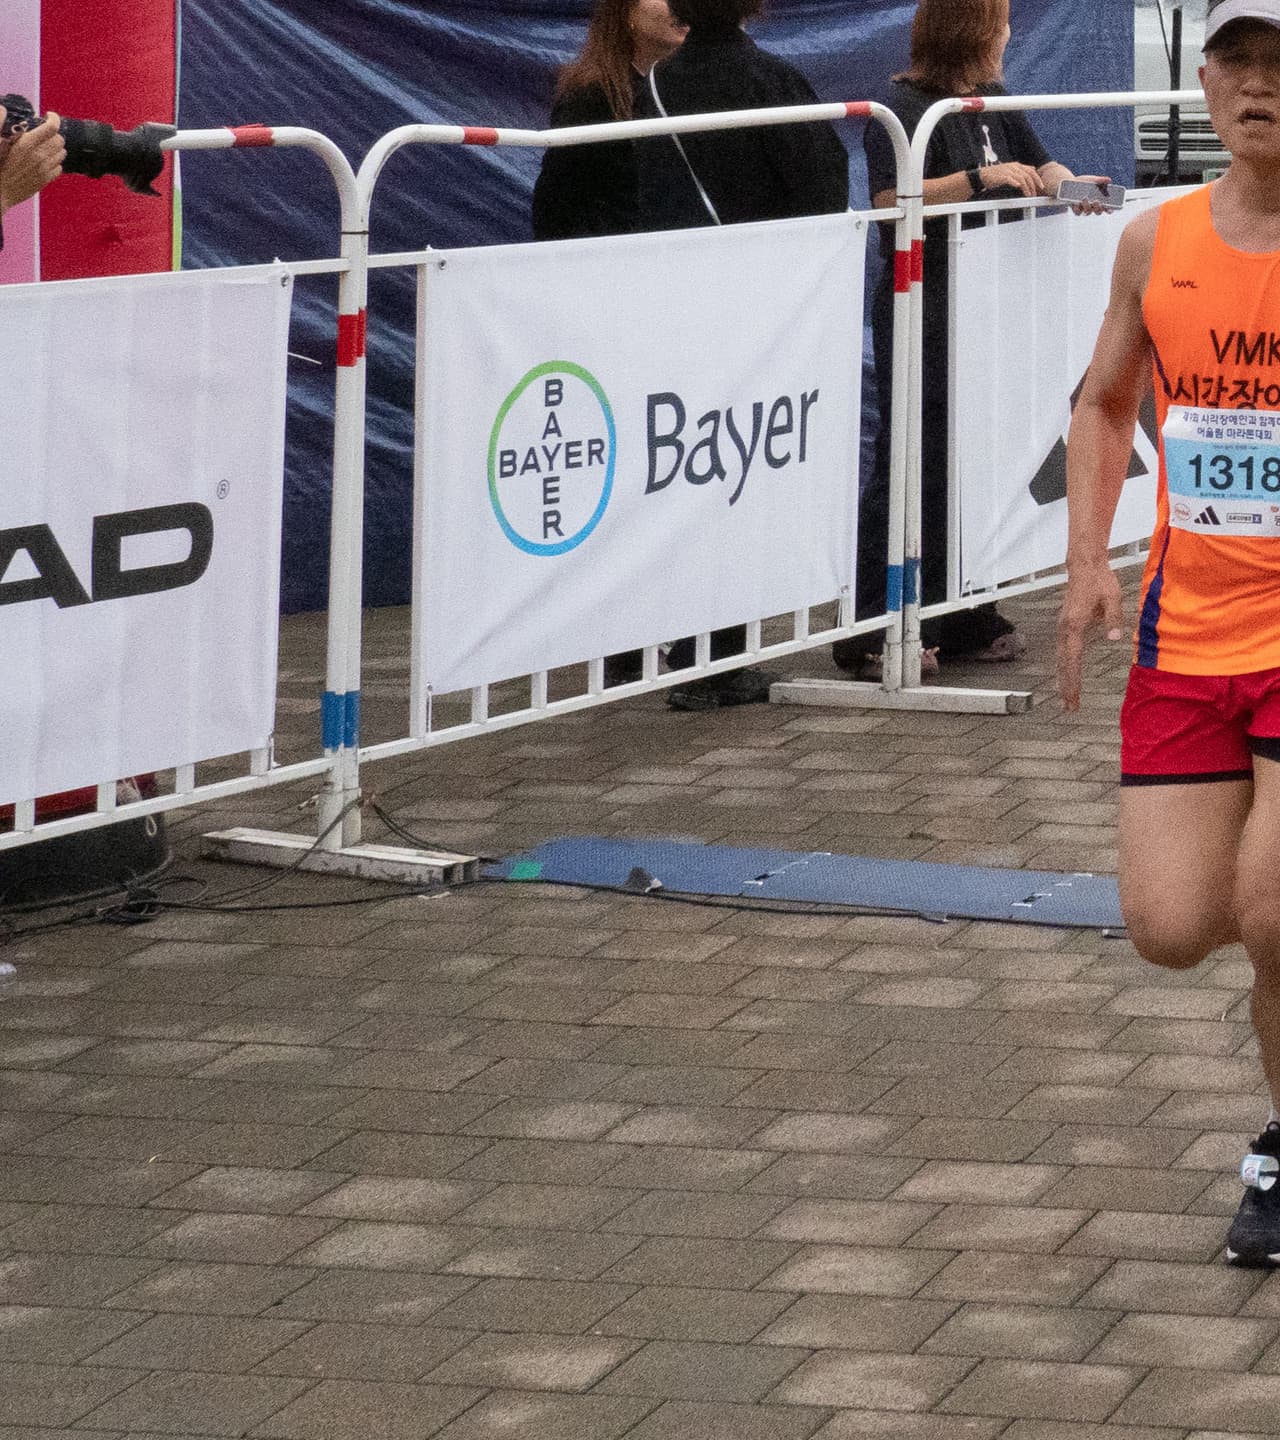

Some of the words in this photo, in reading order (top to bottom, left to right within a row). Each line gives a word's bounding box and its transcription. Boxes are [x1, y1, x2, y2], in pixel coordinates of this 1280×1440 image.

[499, 437, 606, 479] BAYER
[541, 378, 565, 540] BAYER
[644, 388, 820, 507] Bayer
